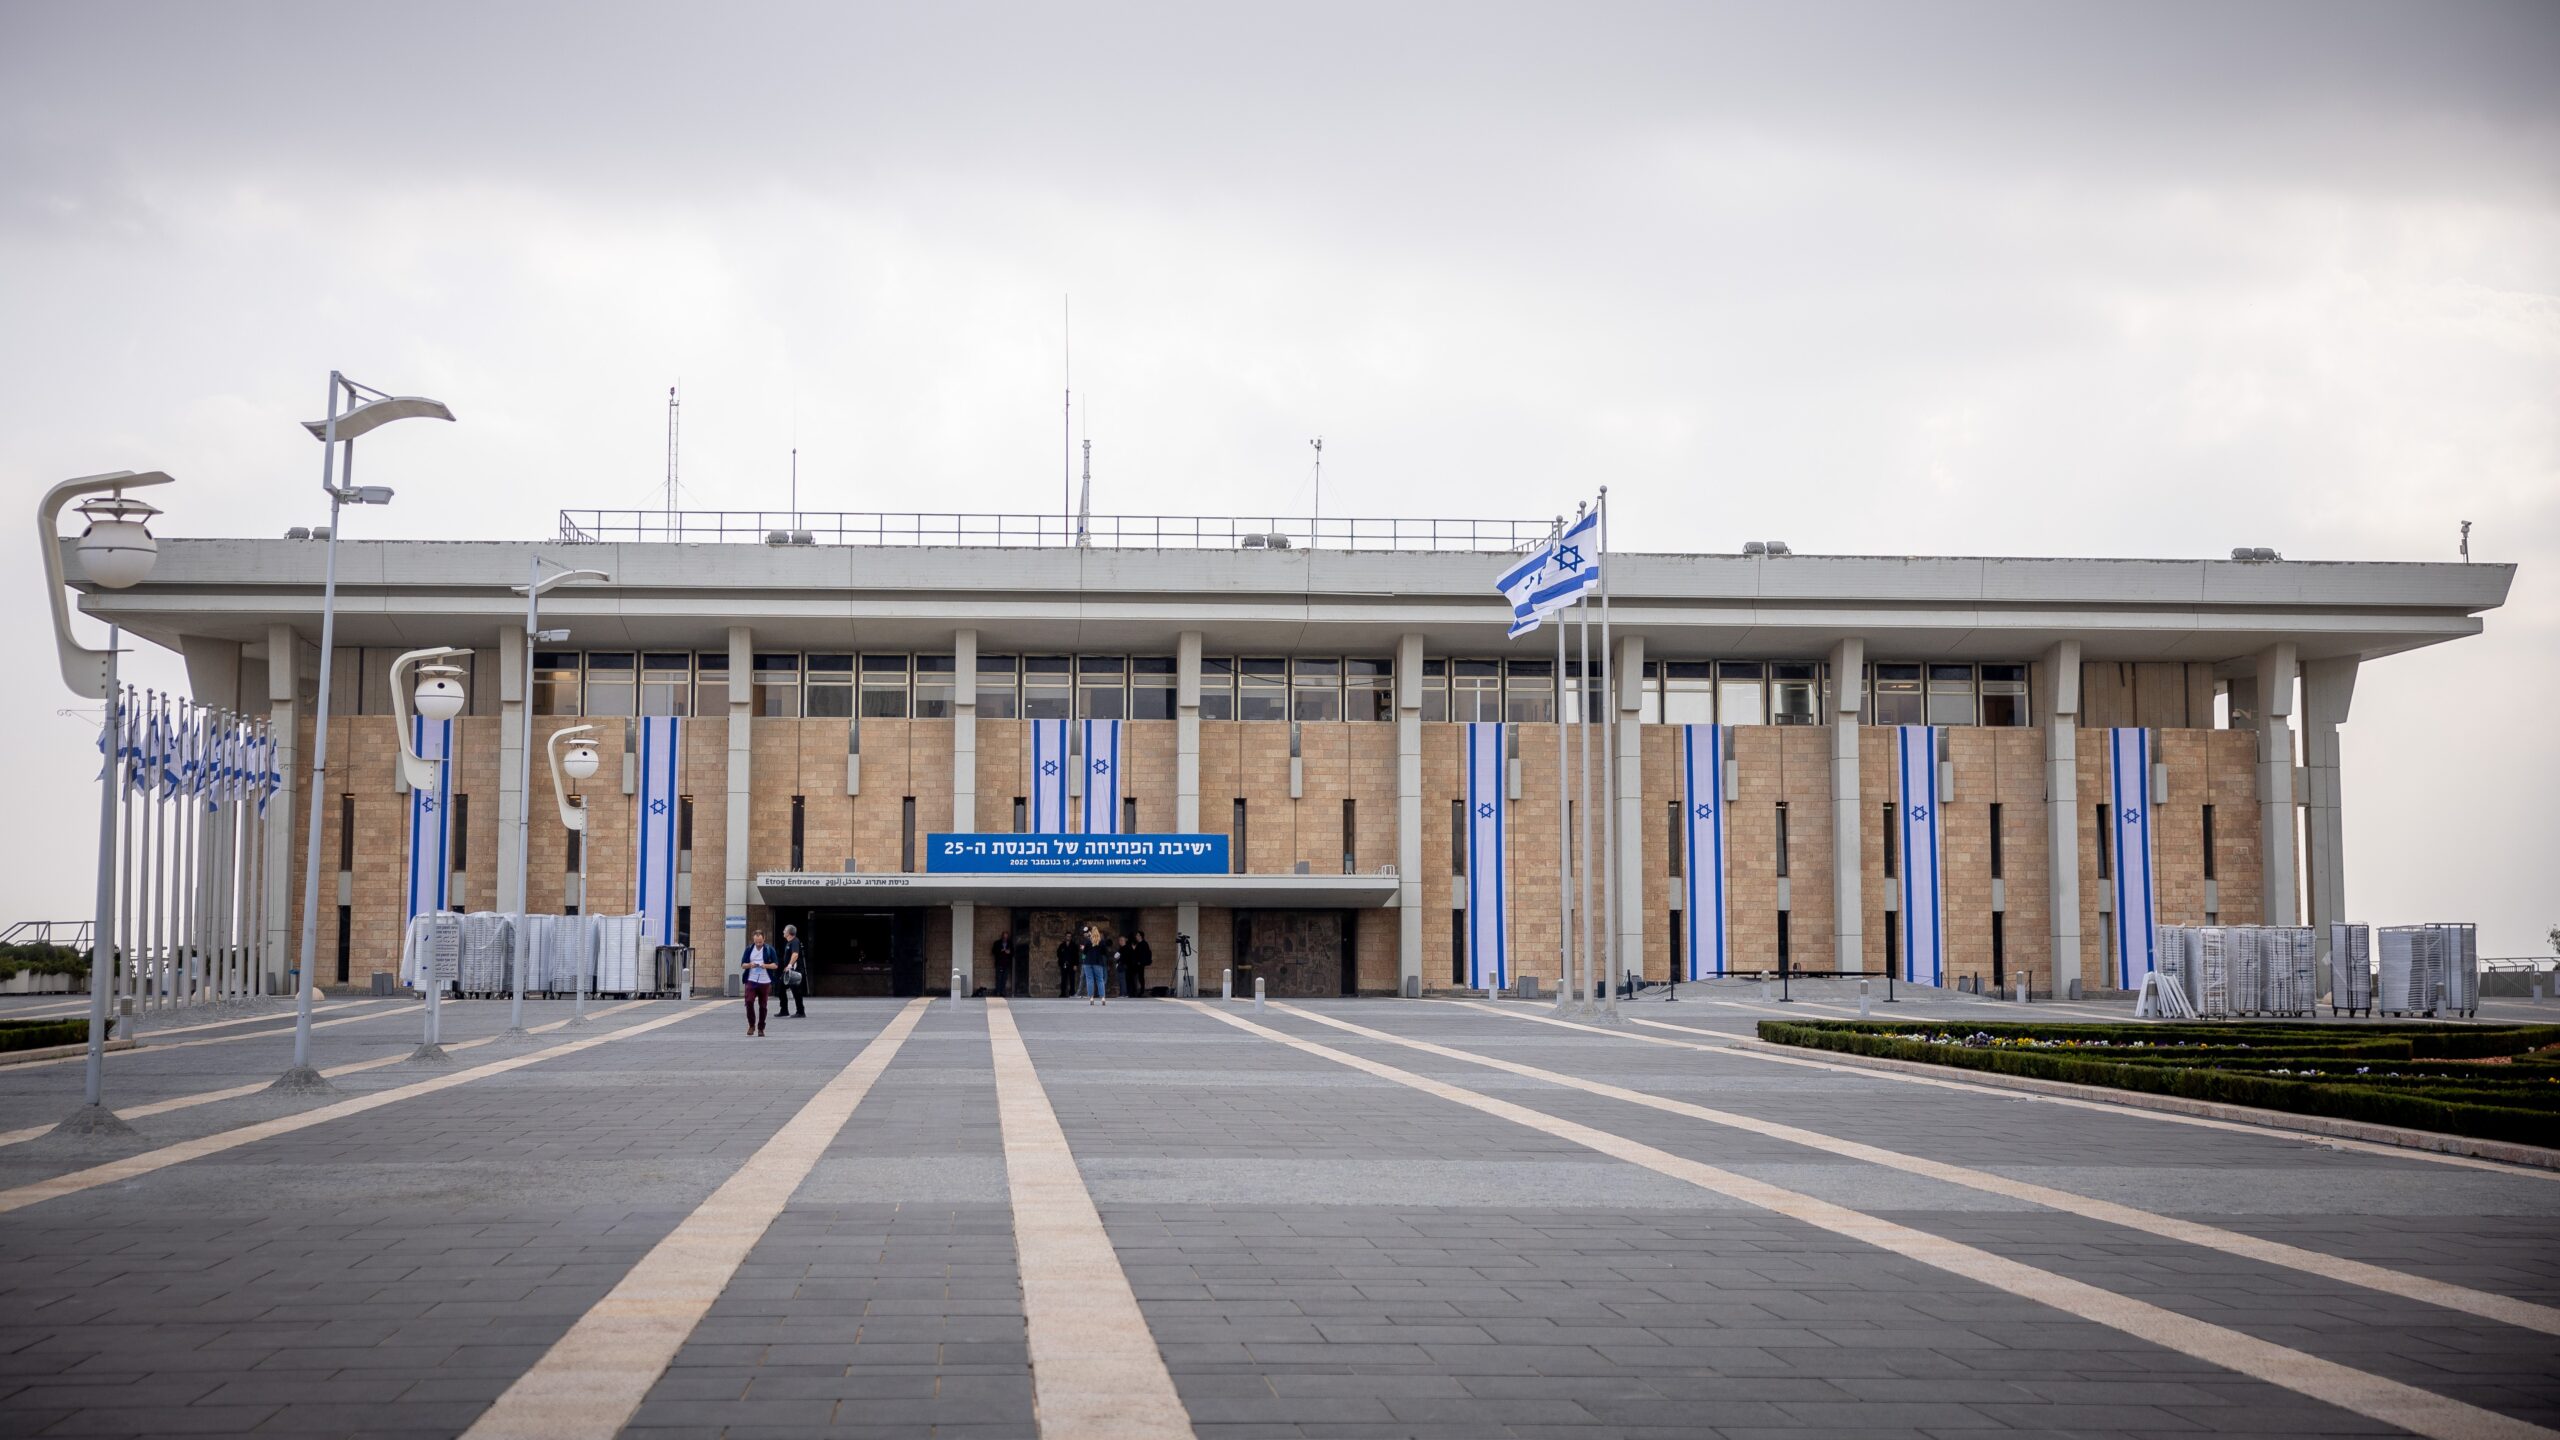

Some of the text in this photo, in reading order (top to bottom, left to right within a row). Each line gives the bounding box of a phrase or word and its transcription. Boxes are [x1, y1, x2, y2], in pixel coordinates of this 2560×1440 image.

[944, 838, 1212, 856] ישיבת הפתיחה של הכנסת ה-25
[1009, 858, 1029, 866] 2022
[1031, 858, 1061, 866] בנובמבר
[1106, 858, 1131, 867] בחשוון
[765, 878, 820, 887] Etrog Entrance
[864, 878, 910, 886] כניסת אתרוג
